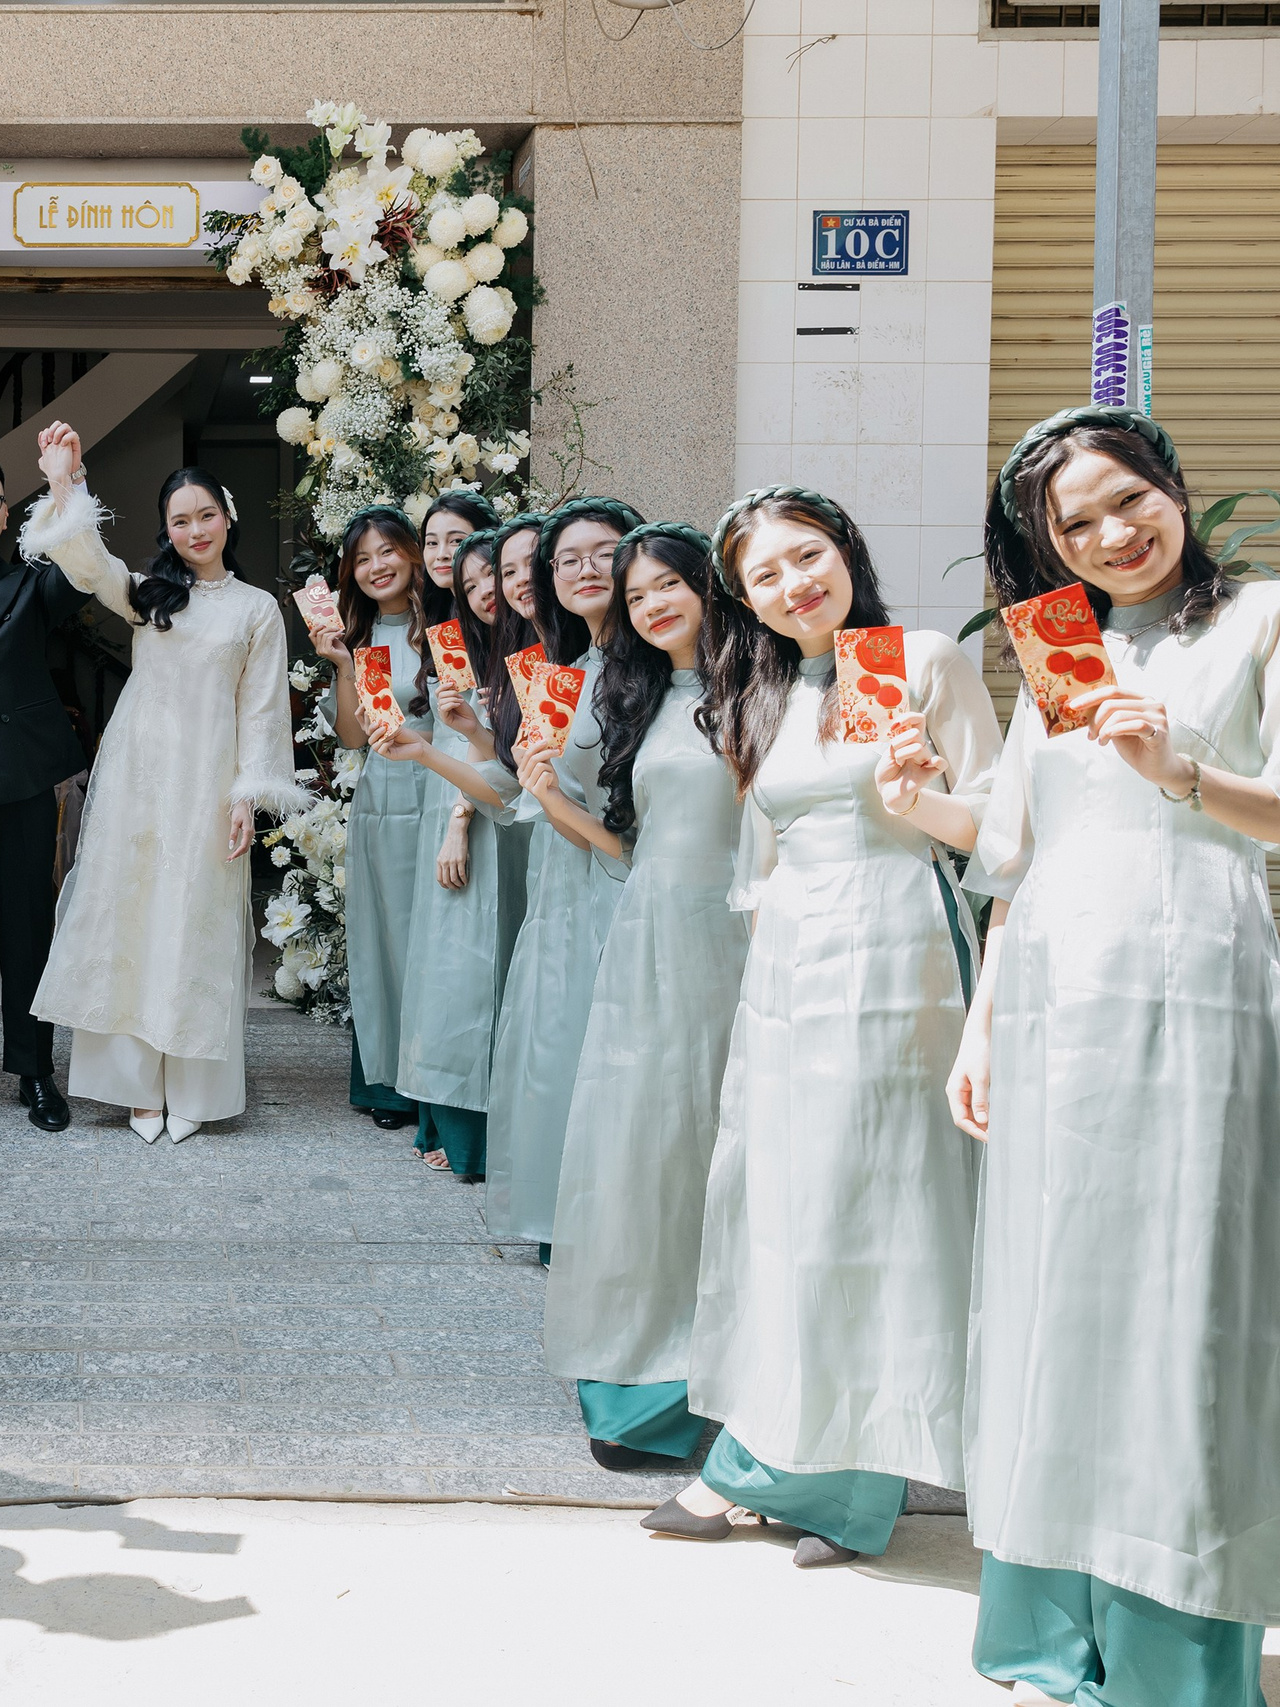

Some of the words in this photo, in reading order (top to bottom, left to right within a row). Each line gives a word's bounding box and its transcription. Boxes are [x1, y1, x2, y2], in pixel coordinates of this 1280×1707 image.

[39, 196, 59, 228] LỄ
[67, 200, 112, 228] ĐÍNH
[121, 200, 173, 229] HÔN
[856, 217, 866, 226] XÁ
[868, 217, 879, 226] BÀ
[881, 215, 902, 226] ĐIỂM
[822, 229, 899, 259] 10C
[821, 260, 835, 270] HẬU
[856, 260, 866, 269] BÀ
